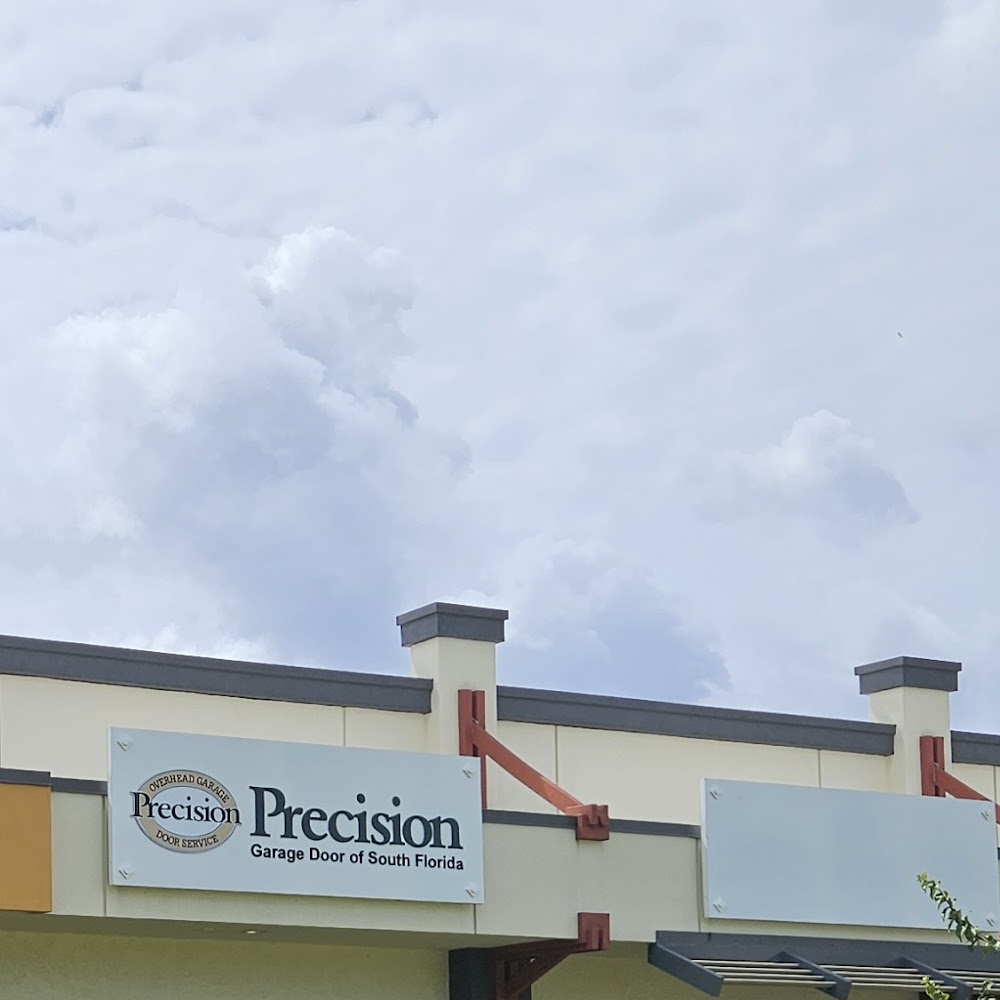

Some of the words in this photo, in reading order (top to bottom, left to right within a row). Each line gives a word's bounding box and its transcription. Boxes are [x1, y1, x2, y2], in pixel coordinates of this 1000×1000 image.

[149, 774, 195, 792] OVERHEAD
[196, 776, 230, 803] GARAGE
[129, 791, 242, 826] Precision
[249, 786, 464, 850] Precision
[156, 830, 180, 847] DOOR
[181, 834, 219, 848] SERVICE
[250, 844, 304, 863] Garage
[309, 847, 345, 862] Door
[350, 851, 364, 864] of
[368, 851, 410, 867] South
[415, 854, 464, 870] Florida
